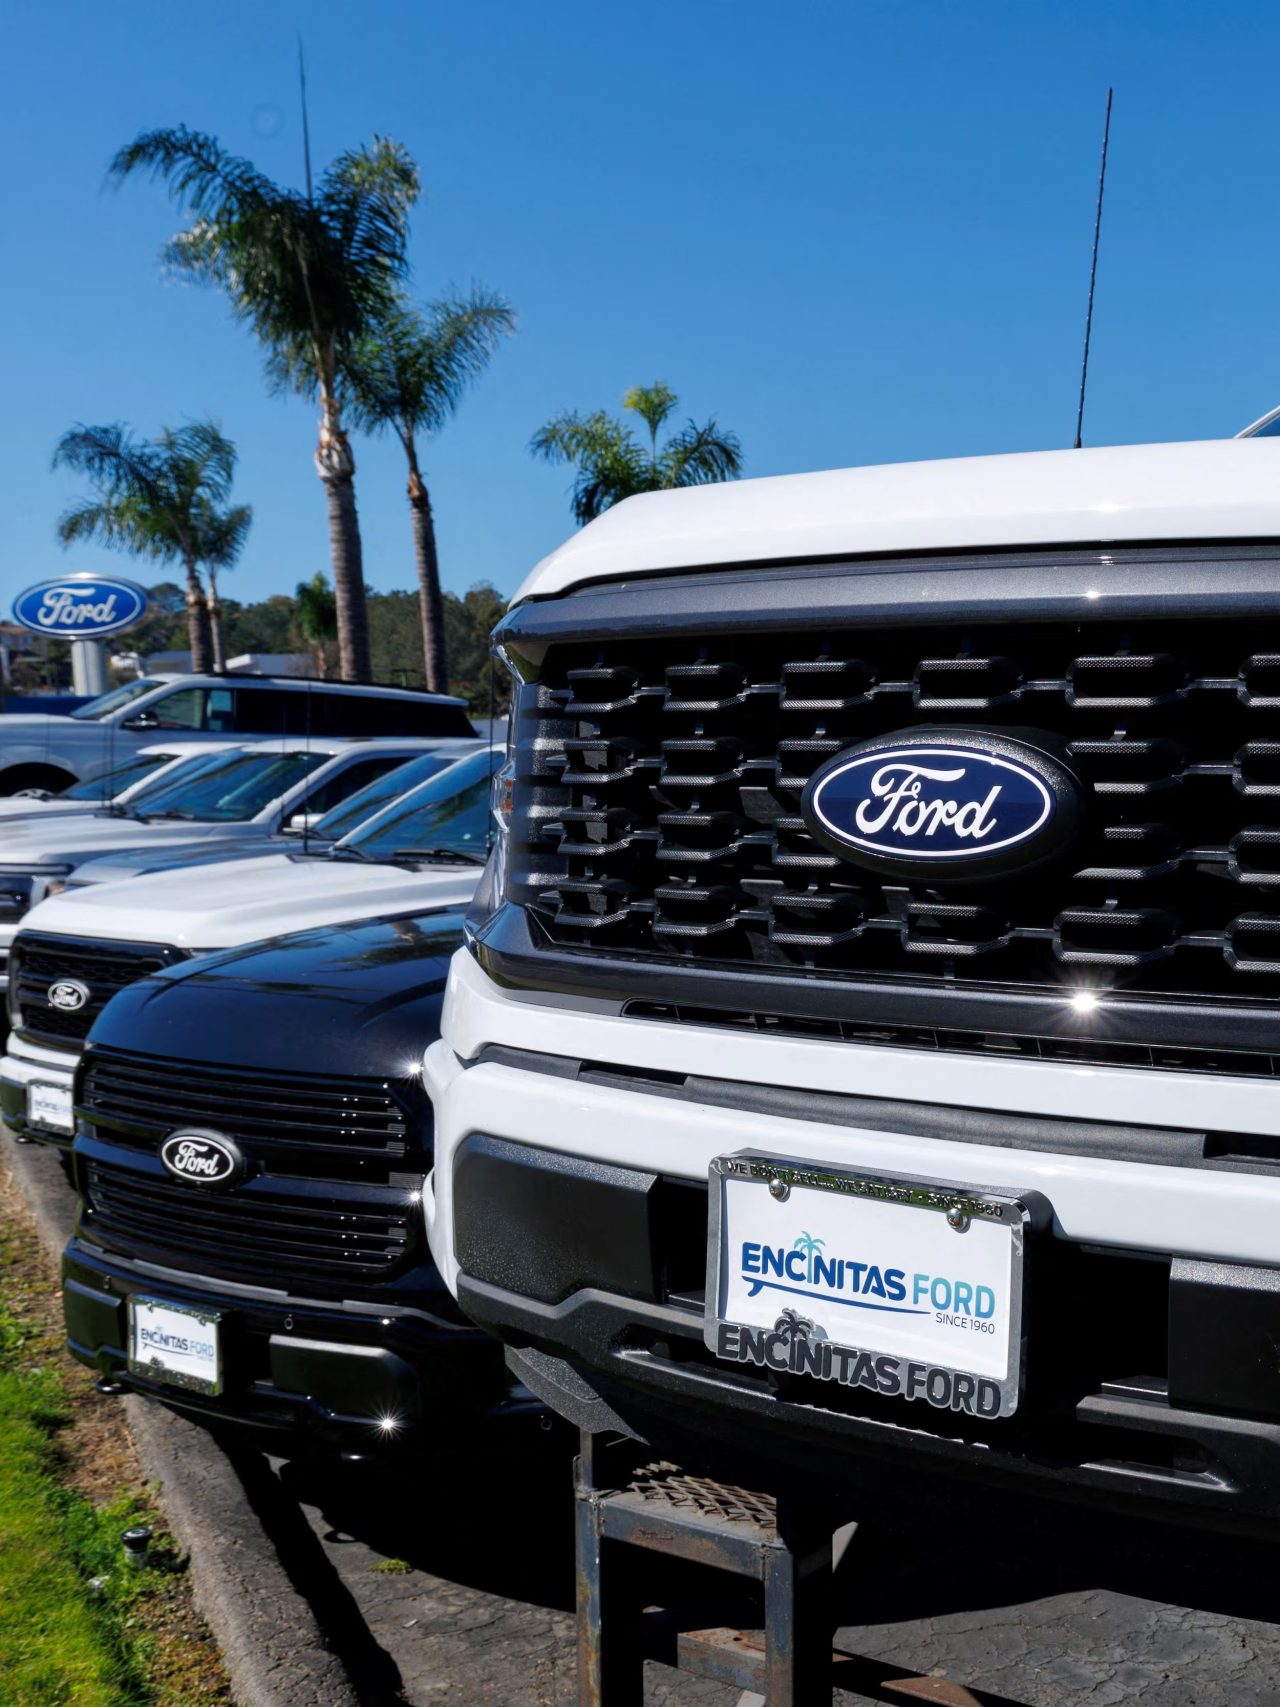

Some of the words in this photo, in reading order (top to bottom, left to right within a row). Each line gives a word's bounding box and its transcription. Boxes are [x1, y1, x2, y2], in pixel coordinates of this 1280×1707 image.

[37, 587, 117, 626] Ford
[855, 763, 1002, 839] Ford
[174, 1141, 219, 1175] Ford
[727, 1160, 749, 1175] WE
[836, 1178, 857, 1193] WE
[859, 1182, 913, 1202] SATISFY
[928, 1193, 968, 1211] SINCE
[971, 1200, 1003, 1217] 1960
[742, 1241, 906, 1301] ENCINITAS
[913, 1273, 996, 1319] FORD
[141, 1328, 188, 1351] ENCINITAS
[189, 1339, 214, 1358] FORD
[936, 1312, 967, 1329] SINCE
[970, 1319, 995, 1335] 1960
[716, 1322, 901, 1396] ENCINITAS
[905, 1361, 1002, 1420] FORD
